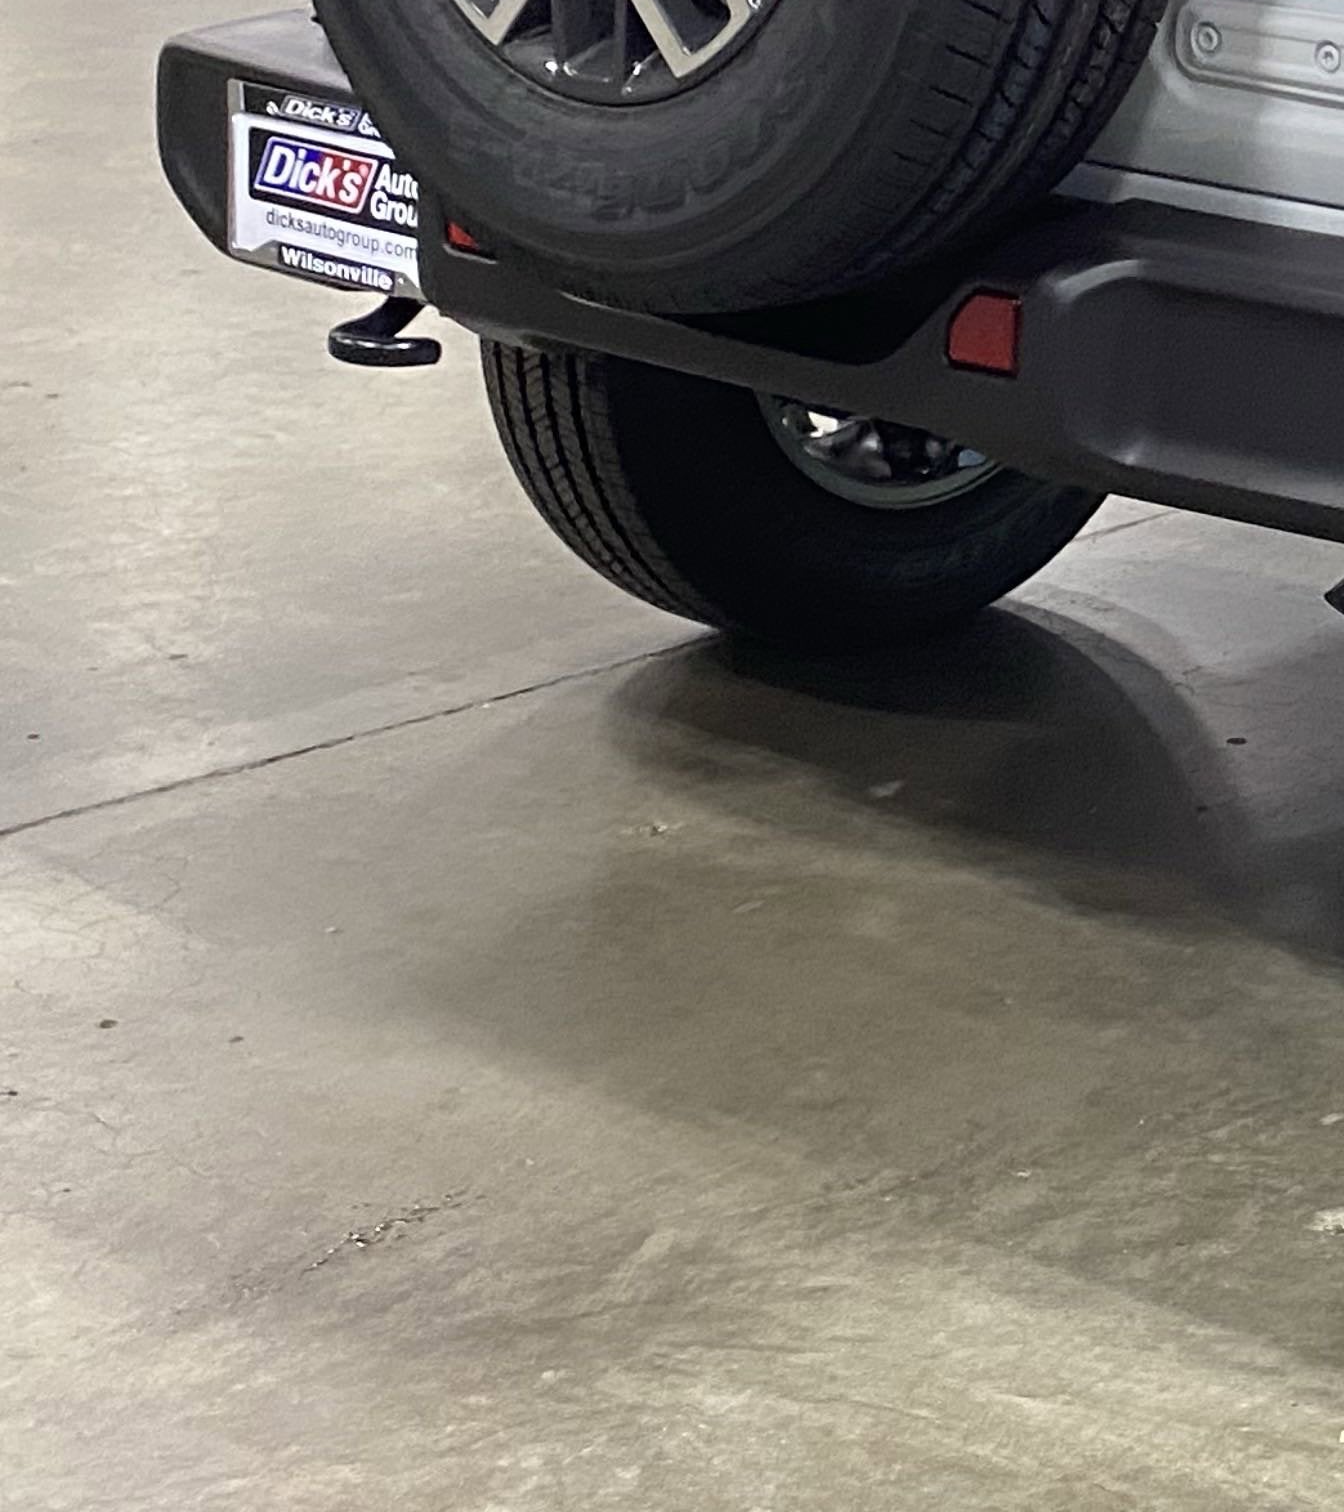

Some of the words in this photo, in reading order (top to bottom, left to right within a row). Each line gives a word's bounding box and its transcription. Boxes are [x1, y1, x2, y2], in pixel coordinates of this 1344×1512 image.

[284, 99, 354, 127] Dick's
[263, 144, 368, 205] Dick's
[370, 189, 419, 228] Grou
[266, 207, 417, 260] dicksautogroup.com
[280, 245, 394, 291] Wilsonville
